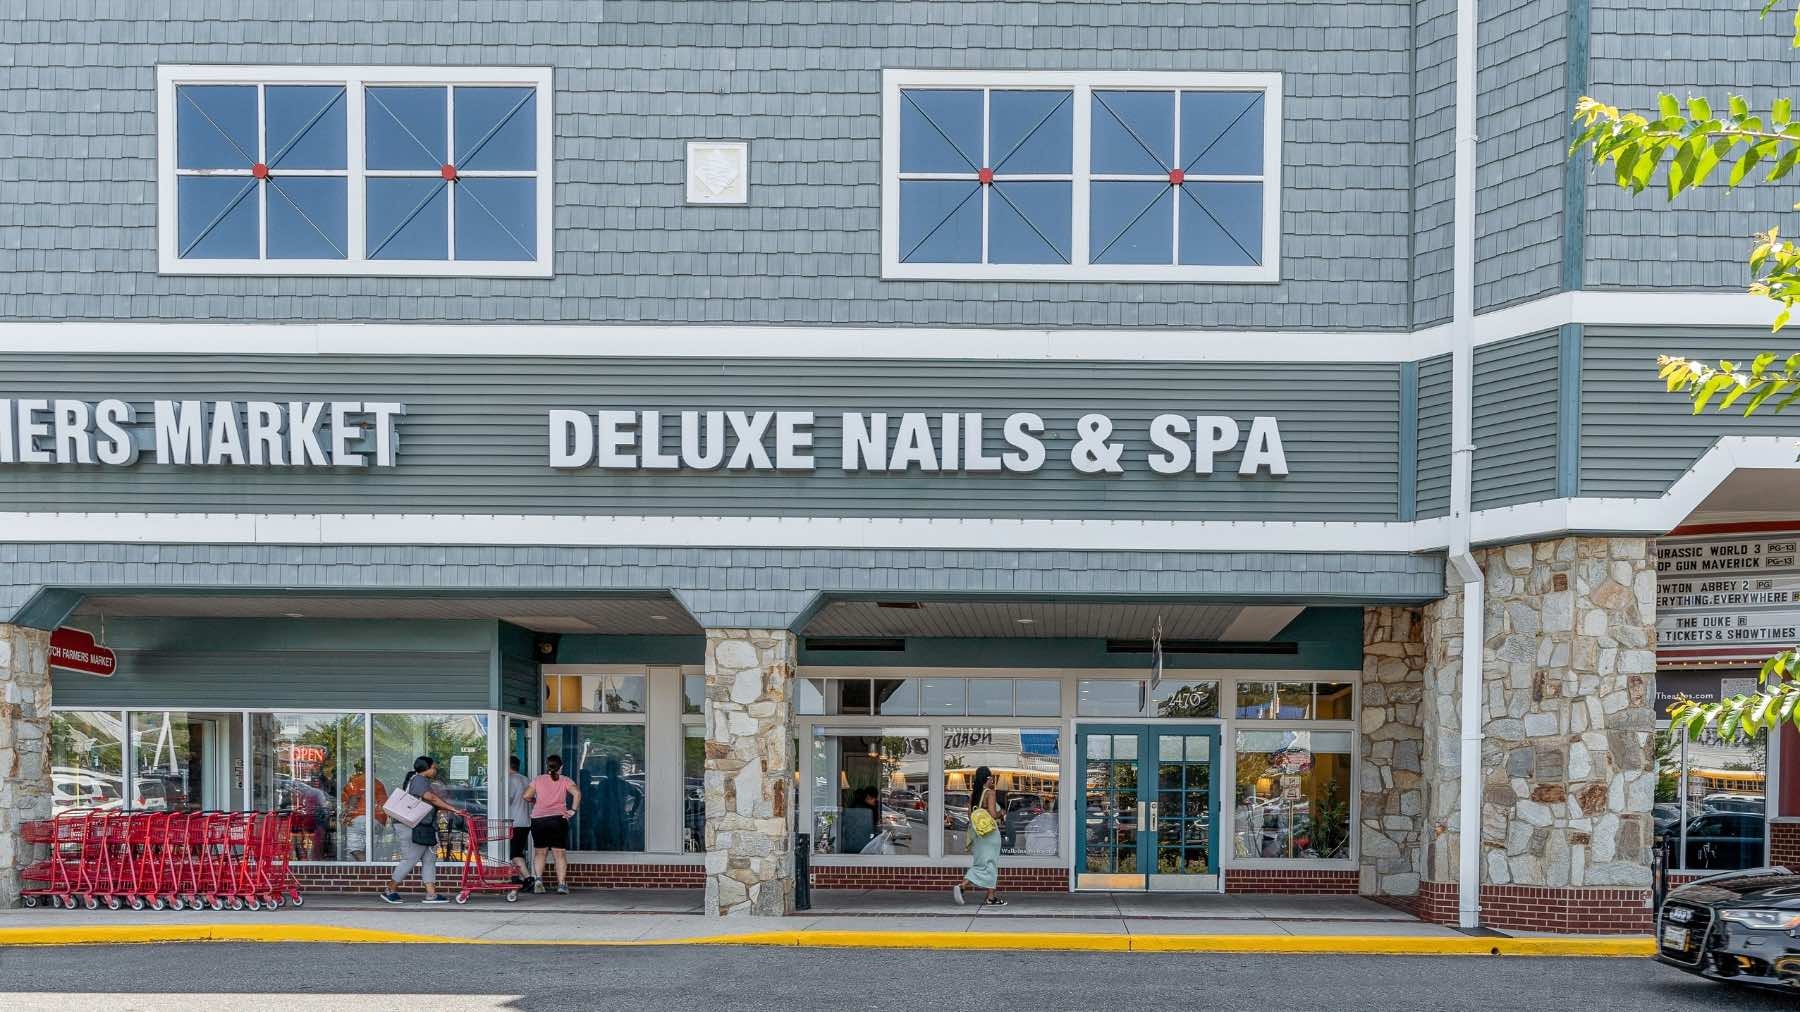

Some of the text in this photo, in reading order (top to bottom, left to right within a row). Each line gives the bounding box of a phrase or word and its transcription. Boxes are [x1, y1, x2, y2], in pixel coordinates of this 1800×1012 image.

[0, 399, 402, 467] ERS MARKET
[550, 410, 1288, 475] DELUXE NAILS & SPA
[1710, 544, 1748, 556] WORLD
[1754, 544, 1761, 554] 3
[1769, 544, 1795, 552] PG-13
[1657, 557, 1793, 572] OP GUN MAVERICK PG-13
[1700, 581, 1737, 593] ABBEY
[1742, 580, 1749, 591] 2
[1758, 581, 1770, 590] PG
[1677, 617, 1697, 628] THE
[1703, 616, 1731, 627] DUKE
[1666, 630, 1712, 641] TICKETS
[1715, 630, 1722, 639] &
[1728, 627, 1796, 640] SHOWTIMES
[62, 648, 89, 664] FARMERS
[90, 653, 113, 668] MARKET
[1168, 691, 1201, 709] 2470
[292, 747, 324, 761] OPEN
